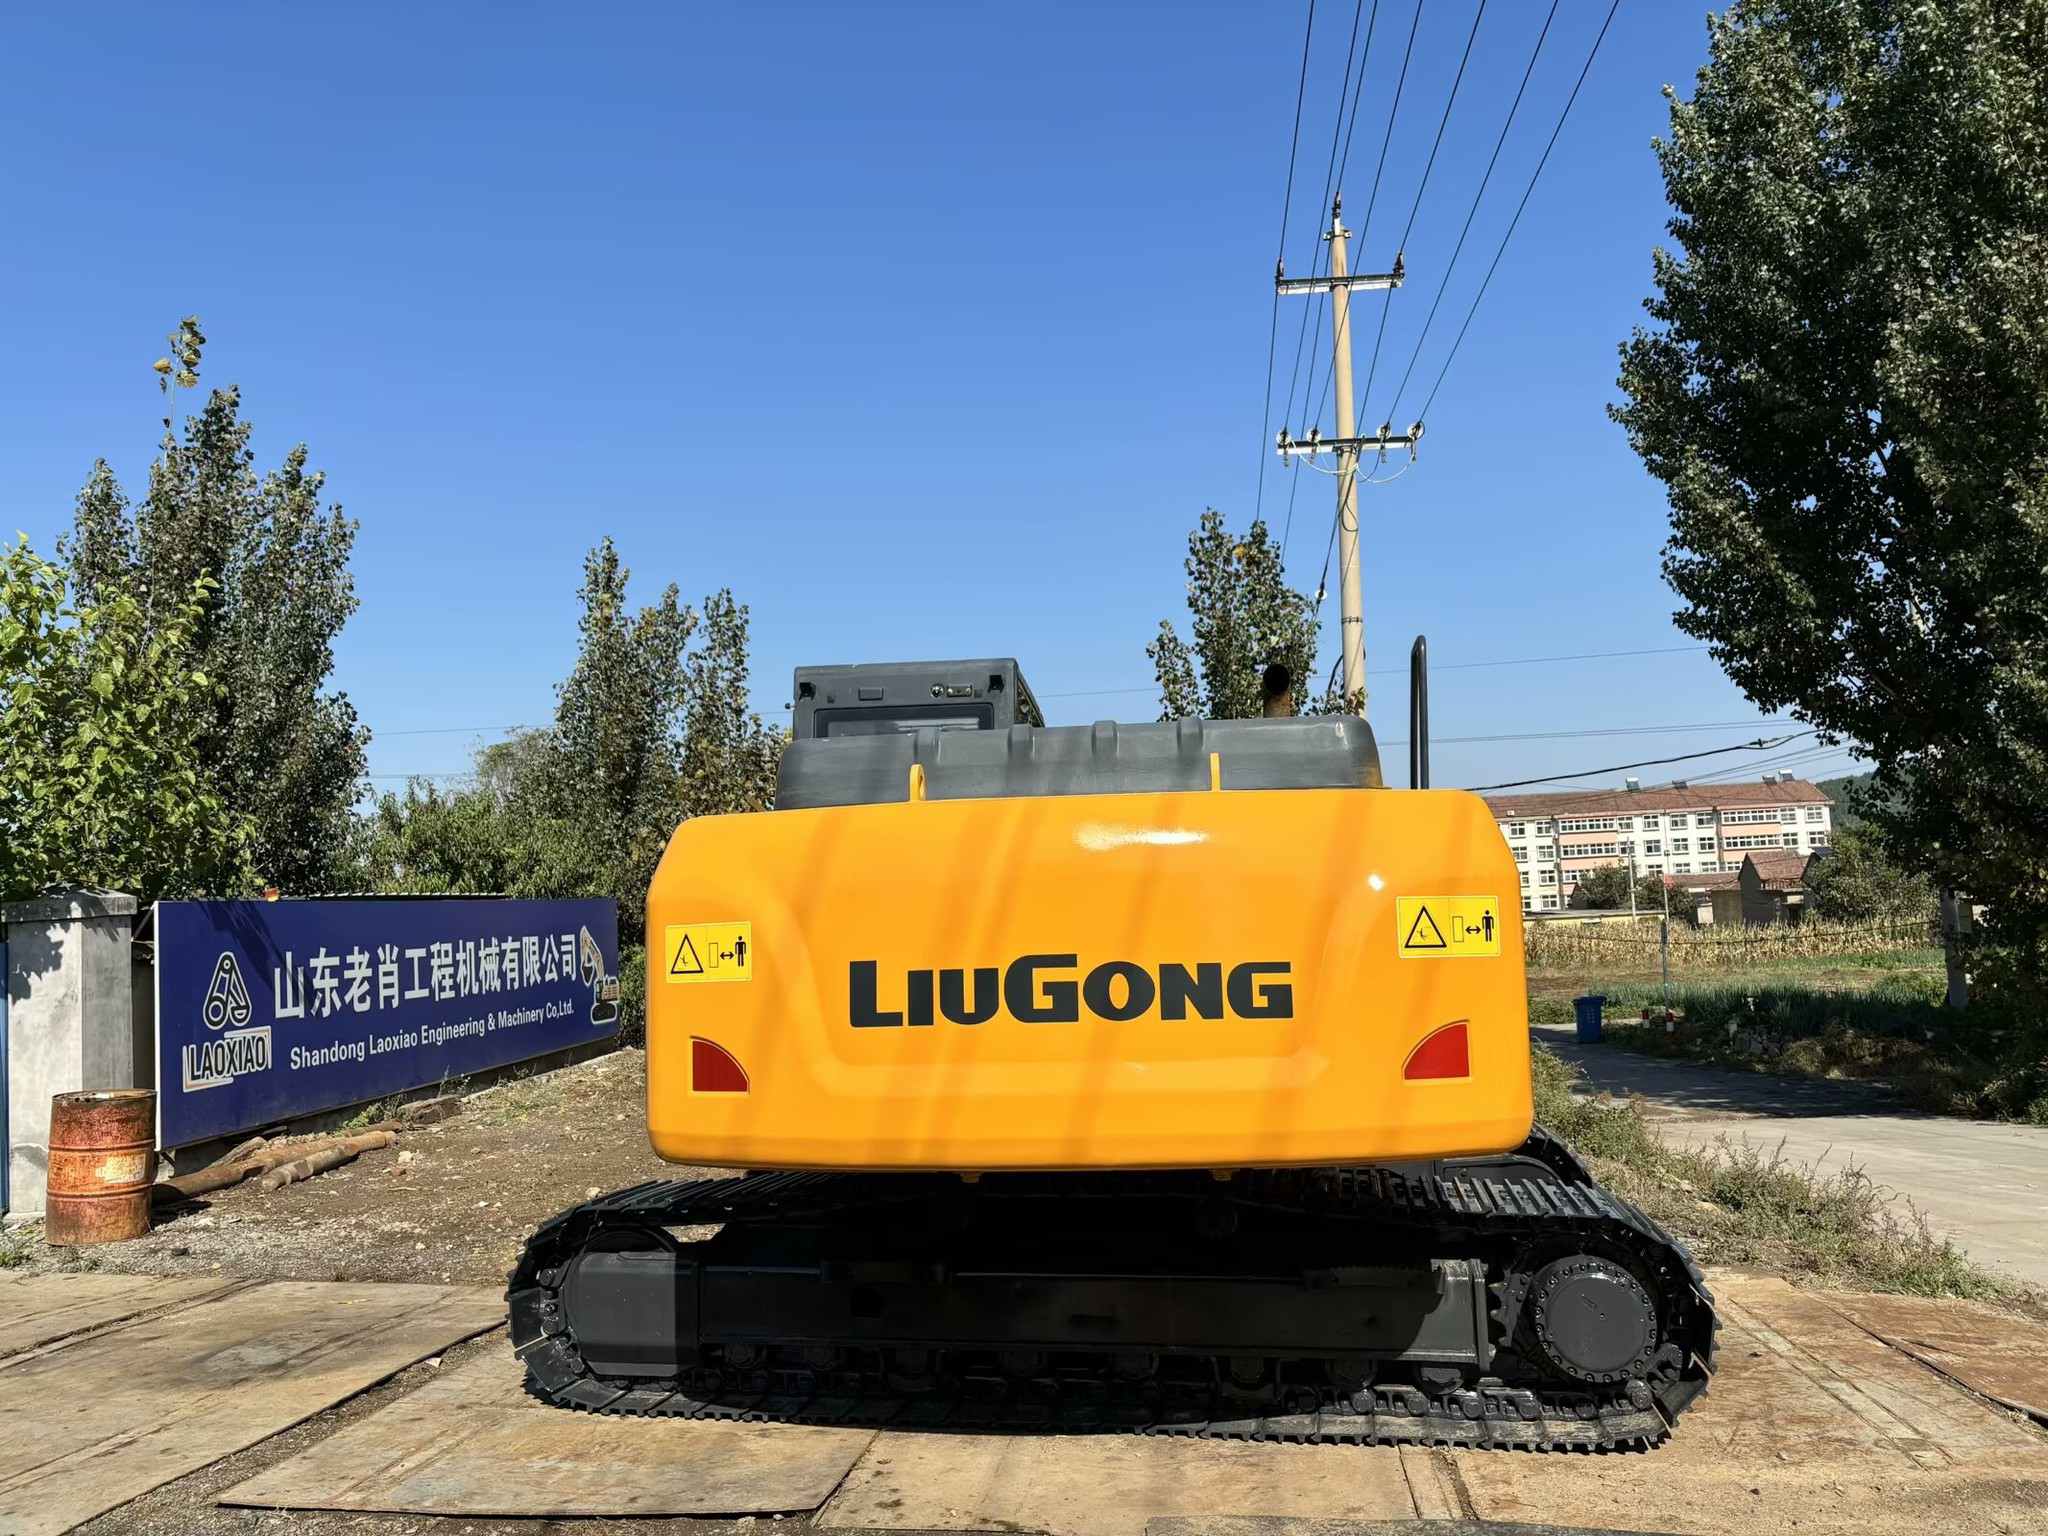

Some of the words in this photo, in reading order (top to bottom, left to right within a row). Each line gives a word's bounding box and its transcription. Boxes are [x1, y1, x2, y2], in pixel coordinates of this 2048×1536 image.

[274, 933, 577, 1020] 山东老肖工程机械有限公司
[189, 1034, 268, 1082] LAOXIAO
[290, 1039, 366, 1071] Shandong
[369, 1029, 418, 1055] Laoxiao
[421, 1016, 485, 1046] Engineering
[487, 1013, 496, 1031] &
[498, 1006, 544, 1029] Machinery
